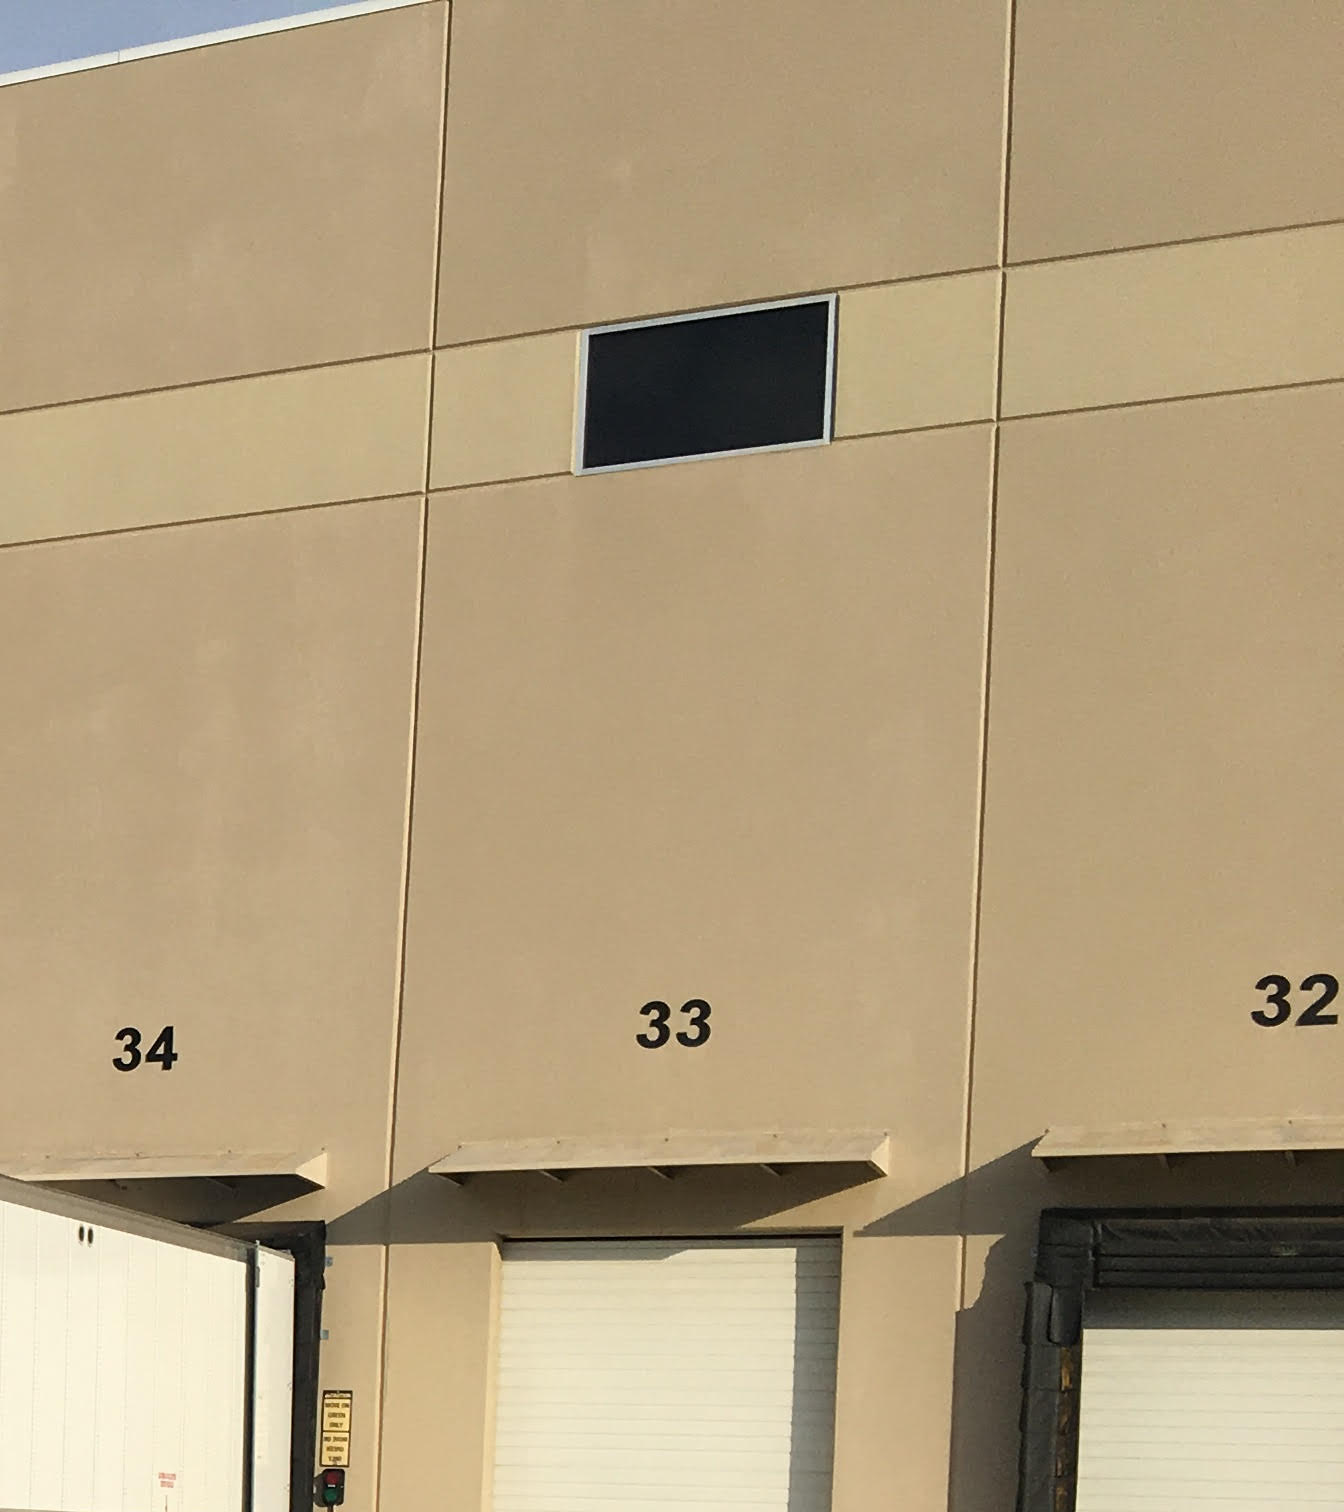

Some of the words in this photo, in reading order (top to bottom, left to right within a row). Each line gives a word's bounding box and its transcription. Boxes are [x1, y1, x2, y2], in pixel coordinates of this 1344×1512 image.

[635, 998, 711, 1049] 33
[1250, 973, 1339, 1027] 32
[112, 1026, 178, 1072] 34
